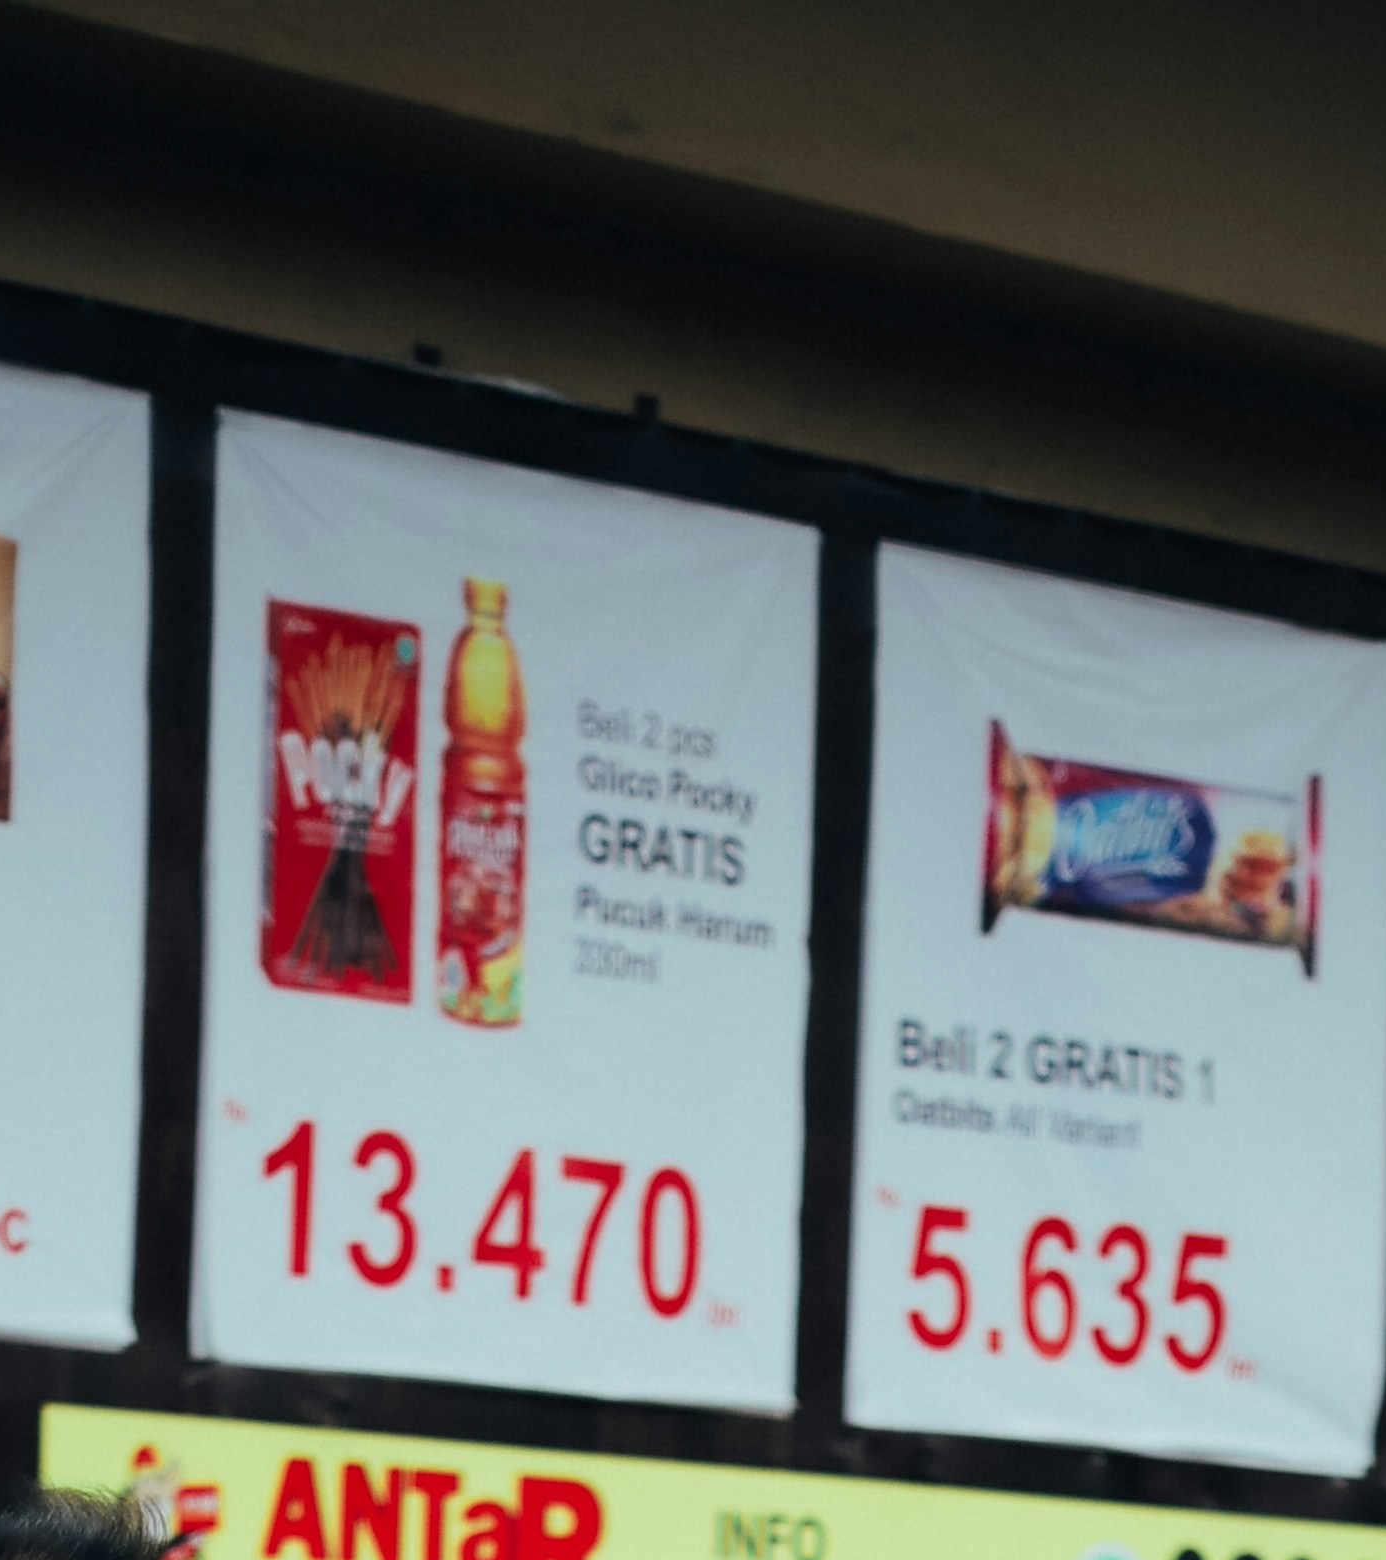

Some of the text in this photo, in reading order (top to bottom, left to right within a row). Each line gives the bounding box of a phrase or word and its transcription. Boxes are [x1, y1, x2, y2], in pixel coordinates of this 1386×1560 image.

[578, 812, 745, 887] GRATIS
[897, 1019, 976, 1077] Beli
[990, 1030, 1013, 1081] 2
[1025, 1034, 1186, 1101] GRATIS
[262, 1119, 703, 1320] 13.470
[906, 1203, 1231, 1373] 5.635
